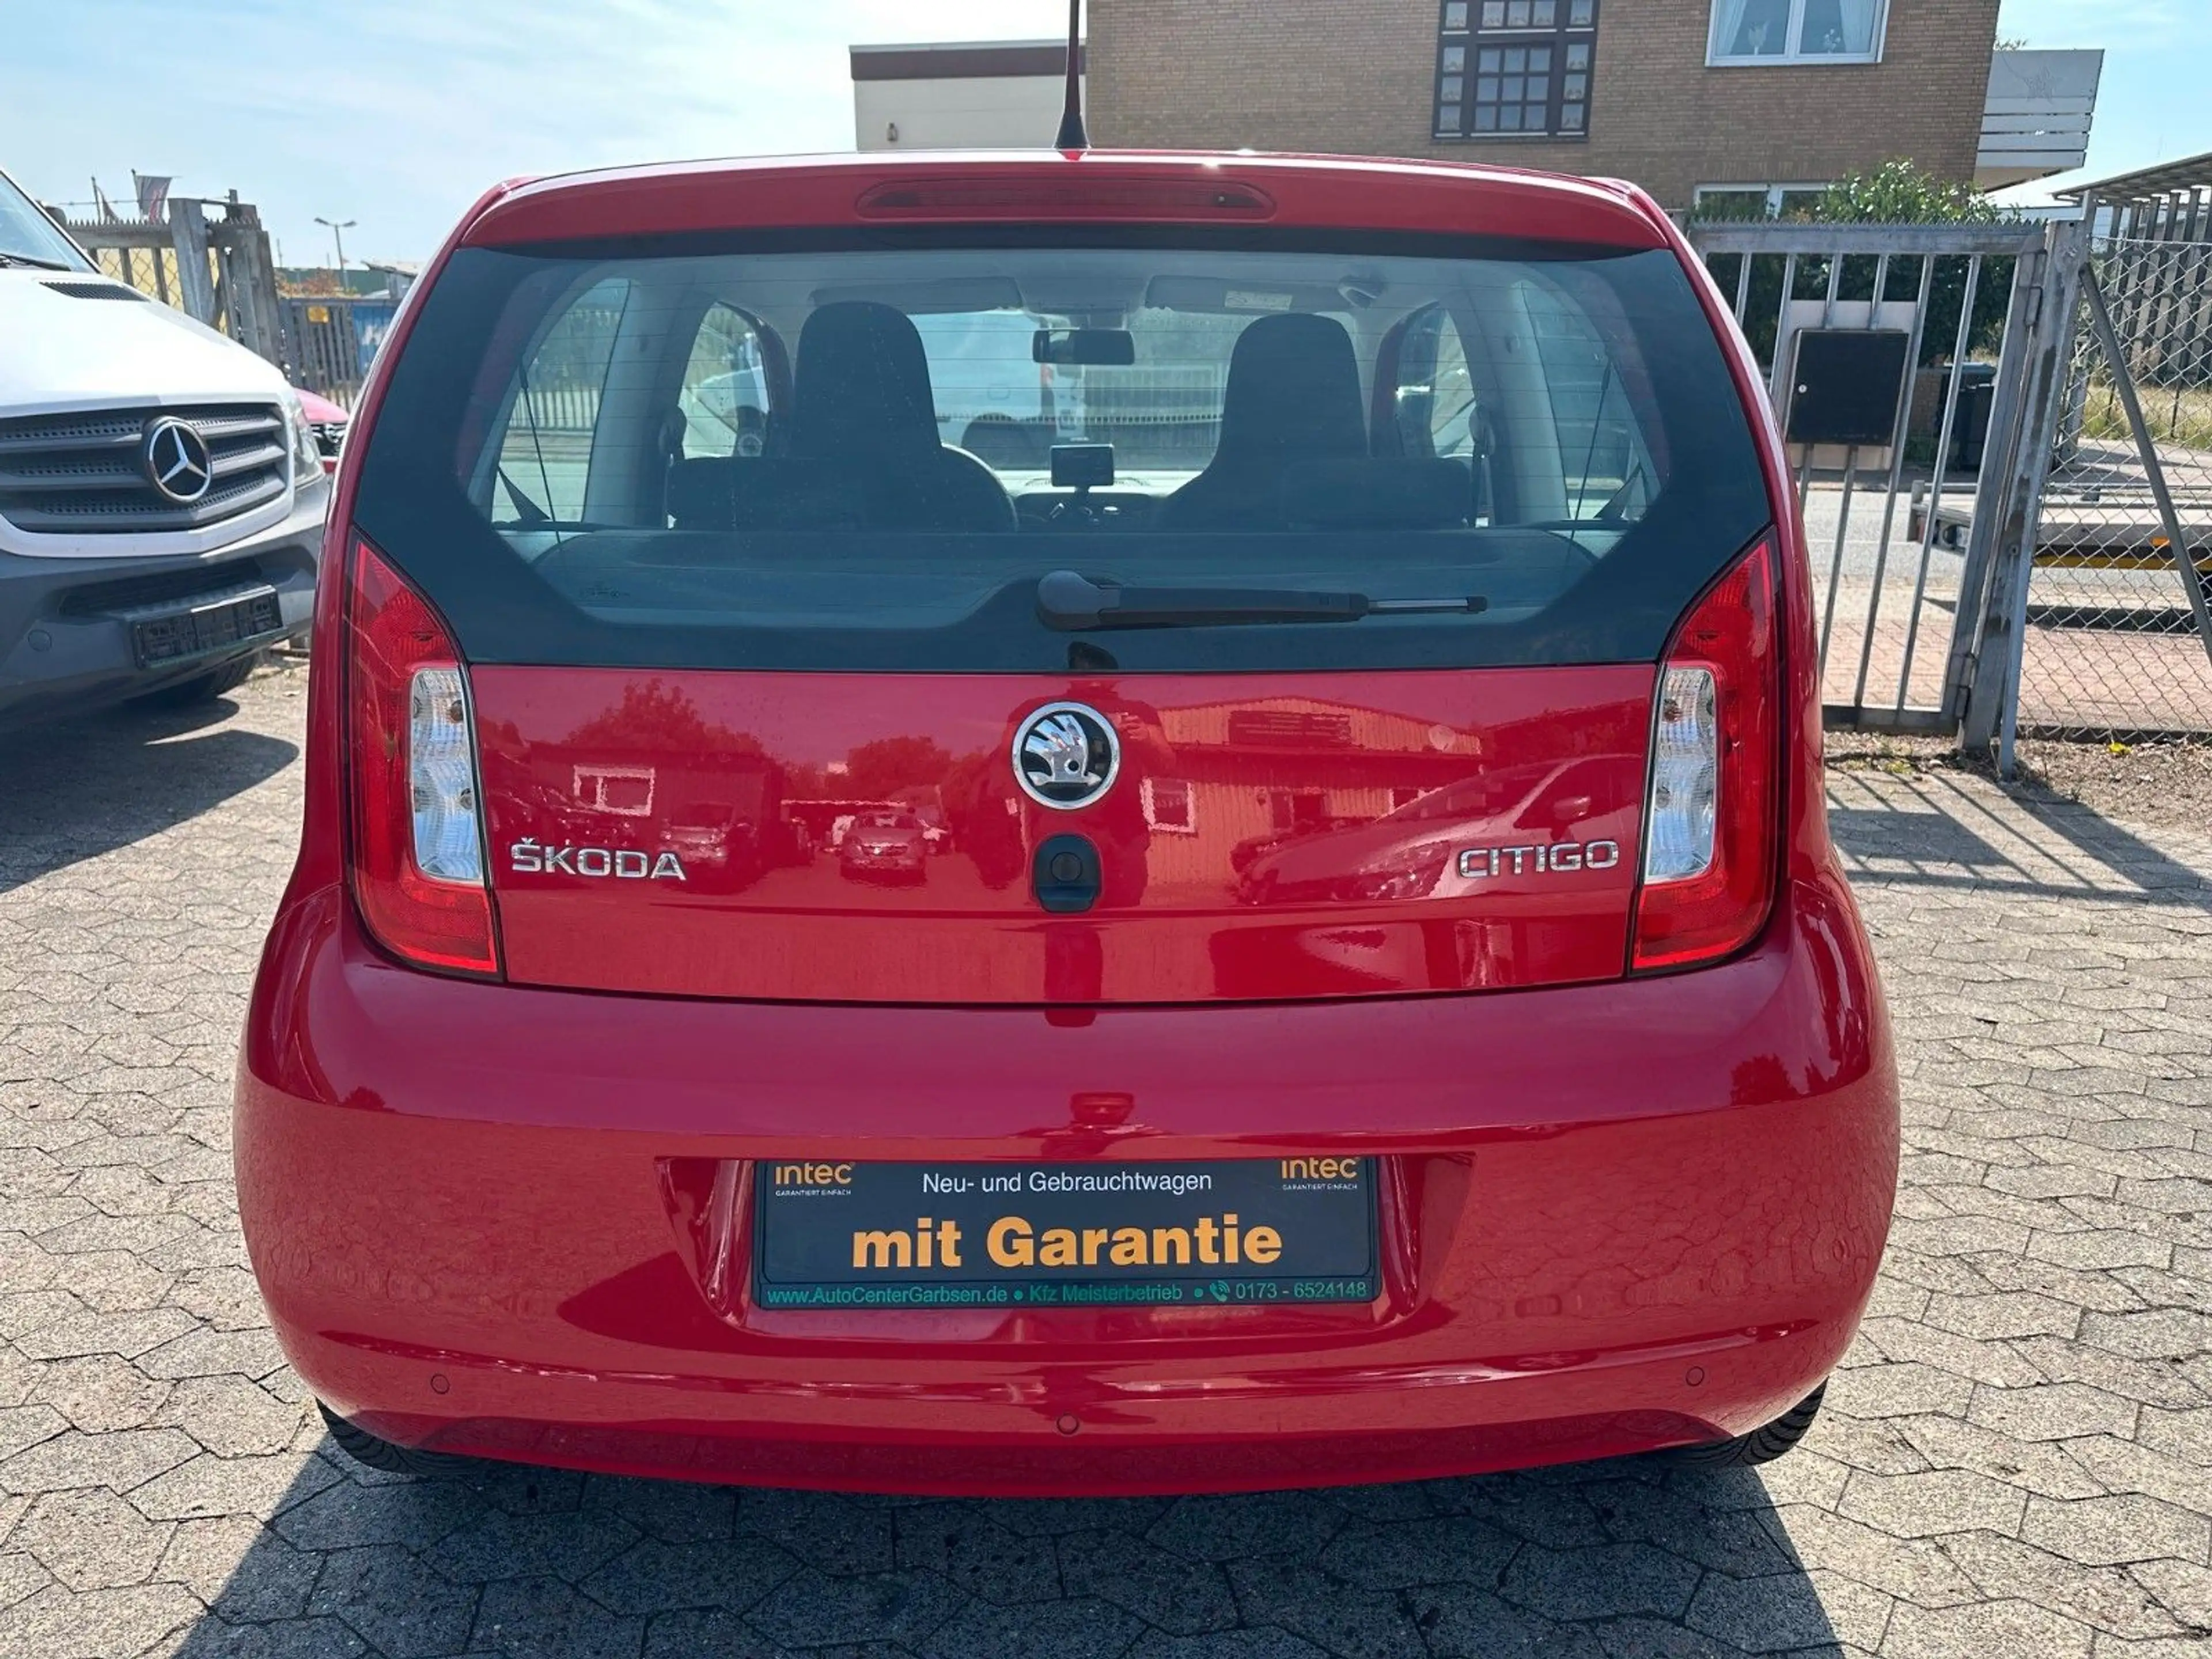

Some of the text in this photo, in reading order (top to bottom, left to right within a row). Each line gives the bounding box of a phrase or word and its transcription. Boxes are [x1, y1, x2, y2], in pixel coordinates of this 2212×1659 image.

[512, 838, 687, 880] ŠKODA
[1459, 840, 1619, 877] CITIGO
[775, 1162, 852, 1185] intec
[1282, 1157, 1358, 1179] intec
[923, 1171, 1211, 1195] Neu- und Gebrauchtwagen
[853, 1213, 1282, 1267] mit Garantie
[767, 1286, 1007, 1303] www.AutoCenterGarbsen.de
[1030, 1285, 1058, 1301] Kfz
[1063, 1285, 1183, 1301] Meisterbetrieb
[1236, 1283, 1278, 1300] 0173
[1294, 1282, 1367, 1299] 6524148
